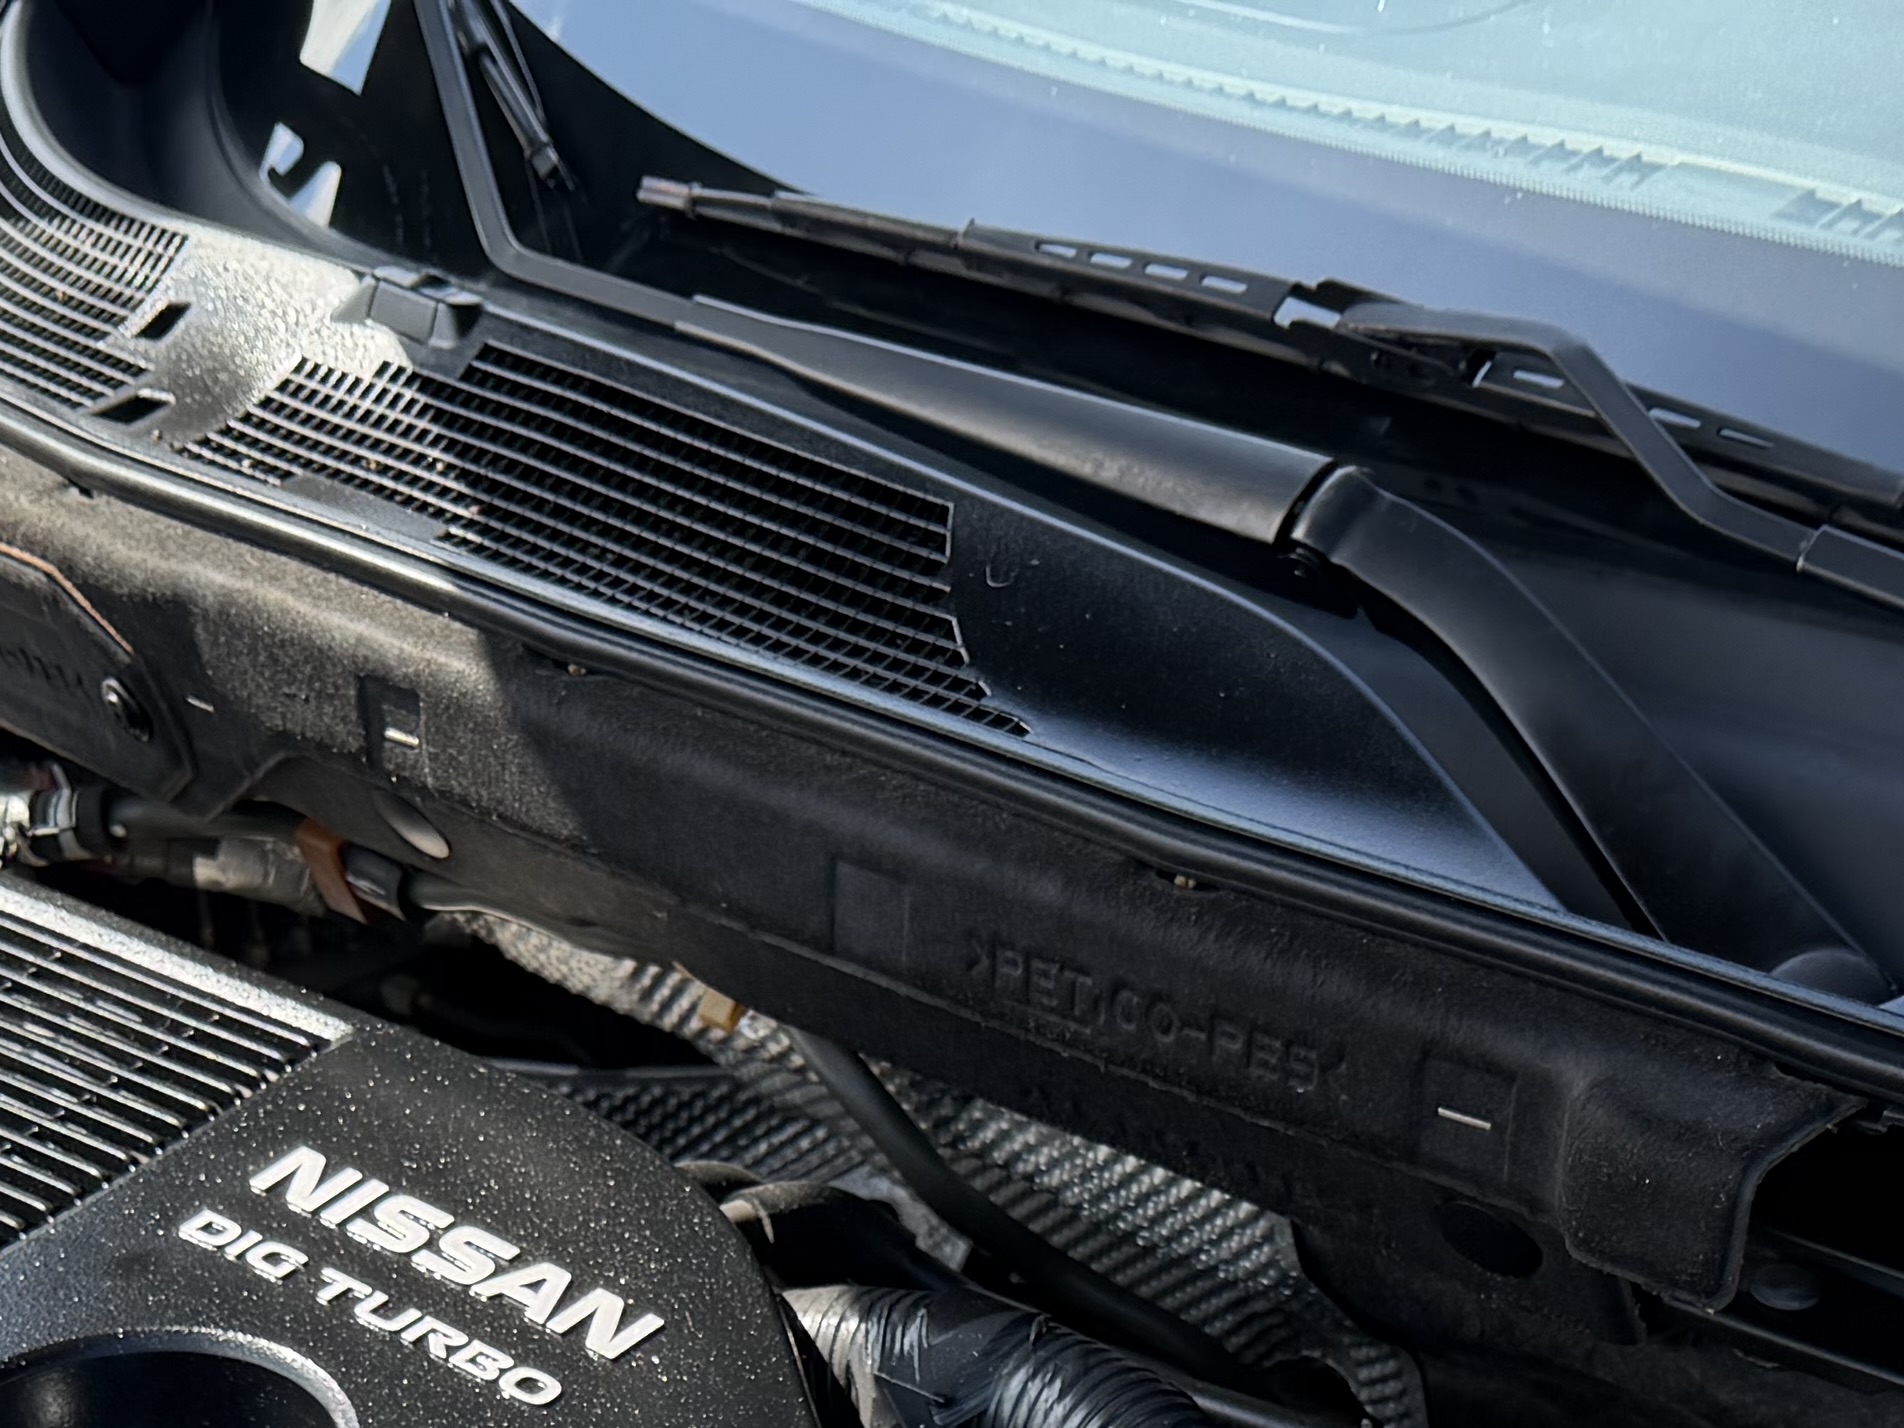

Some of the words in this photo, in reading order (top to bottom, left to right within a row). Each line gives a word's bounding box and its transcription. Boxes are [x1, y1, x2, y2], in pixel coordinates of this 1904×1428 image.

[178, 1209, 309, 1282] DIG
[317, 1268, 563, 1406] TURBO
[249, 1146, 665, 1361] NISSAN
